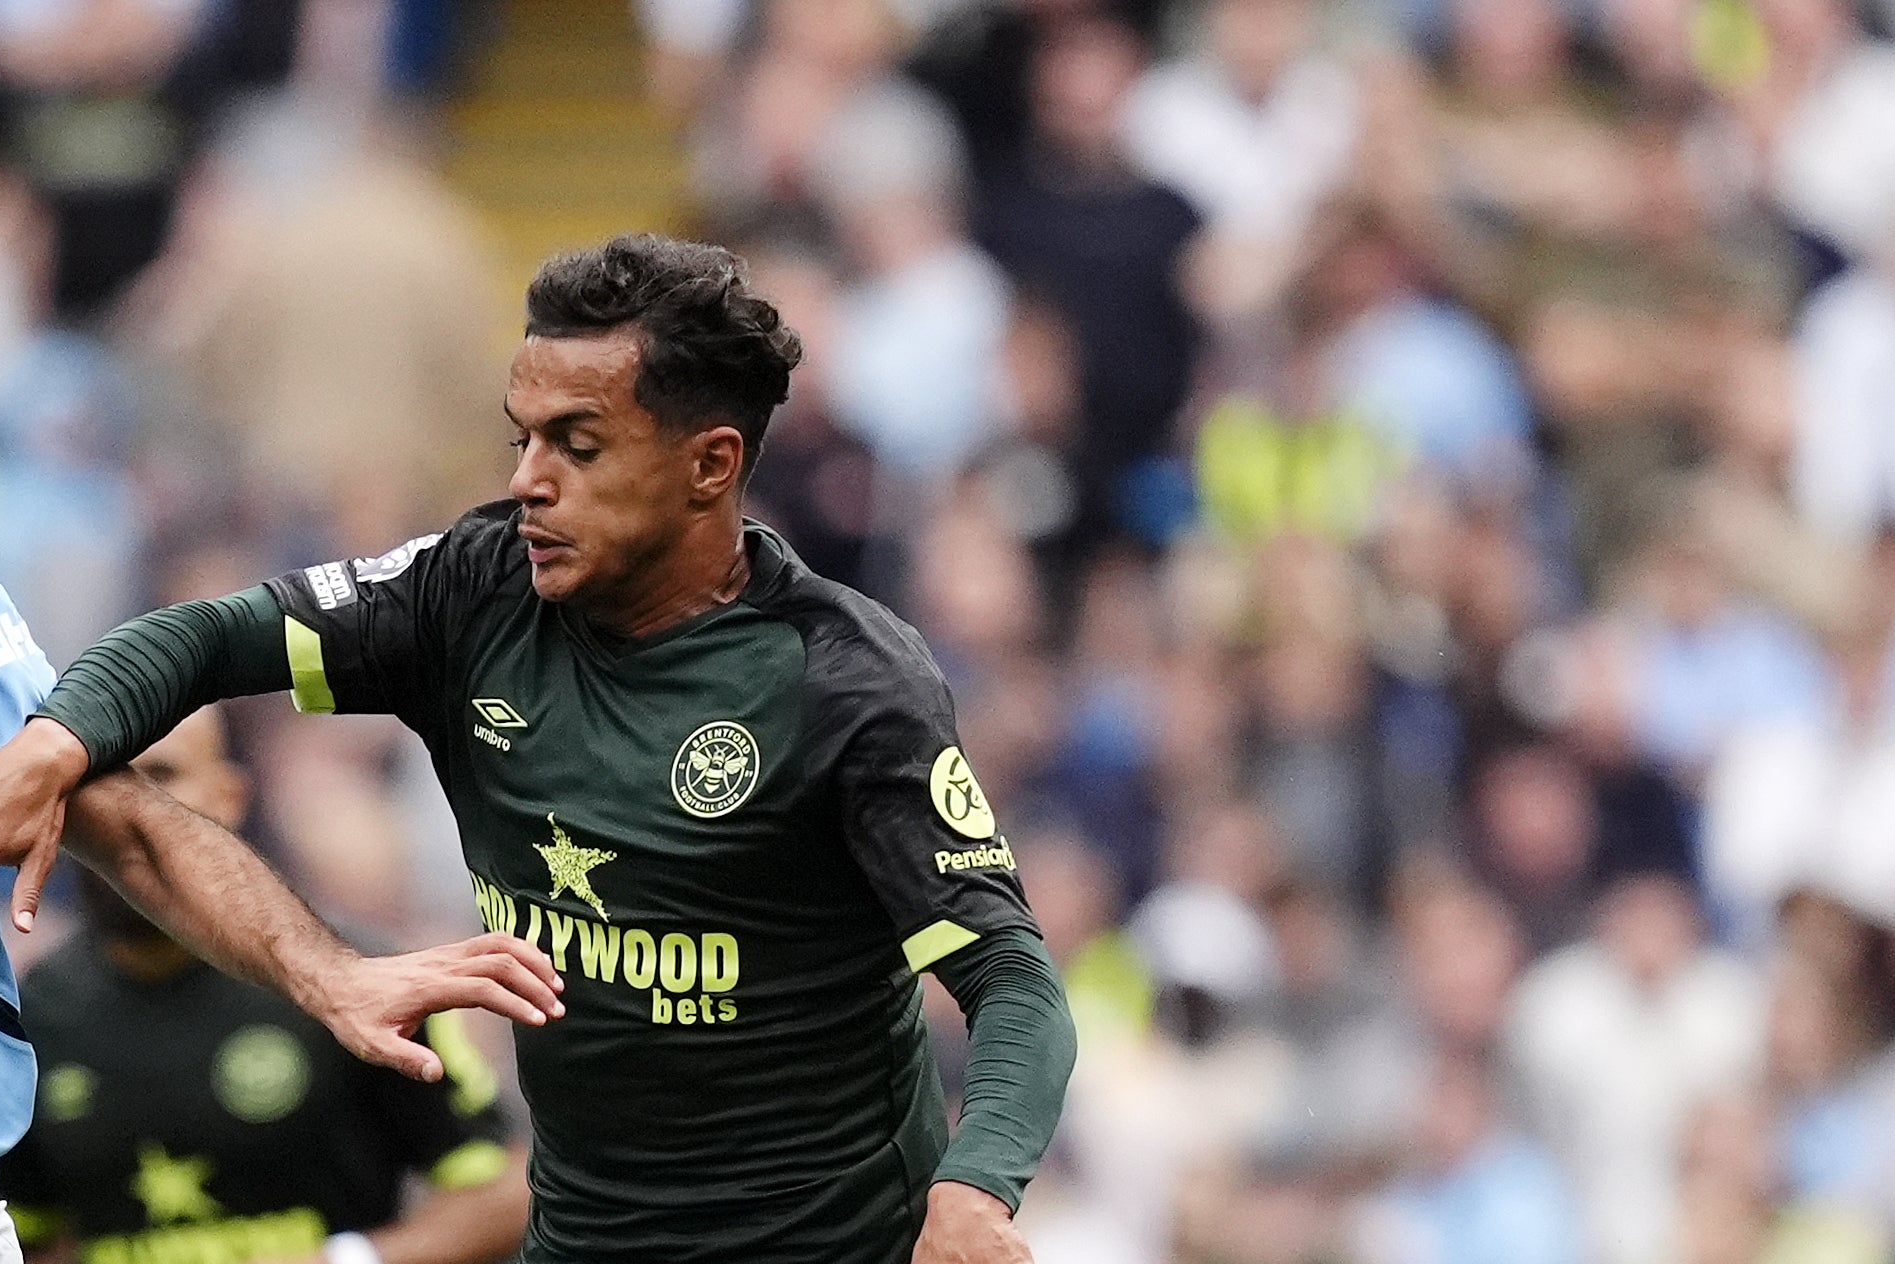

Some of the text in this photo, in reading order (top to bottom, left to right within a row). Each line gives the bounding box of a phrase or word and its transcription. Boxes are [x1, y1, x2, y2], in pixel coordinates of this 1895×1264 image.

[473, 723, 511, 752] umbro
[691, 728, 751, 755] BRENTFORD
[680, 785, 740, 811] FOOTBALL CLUB
[652, 988, 738, 1025] bets
